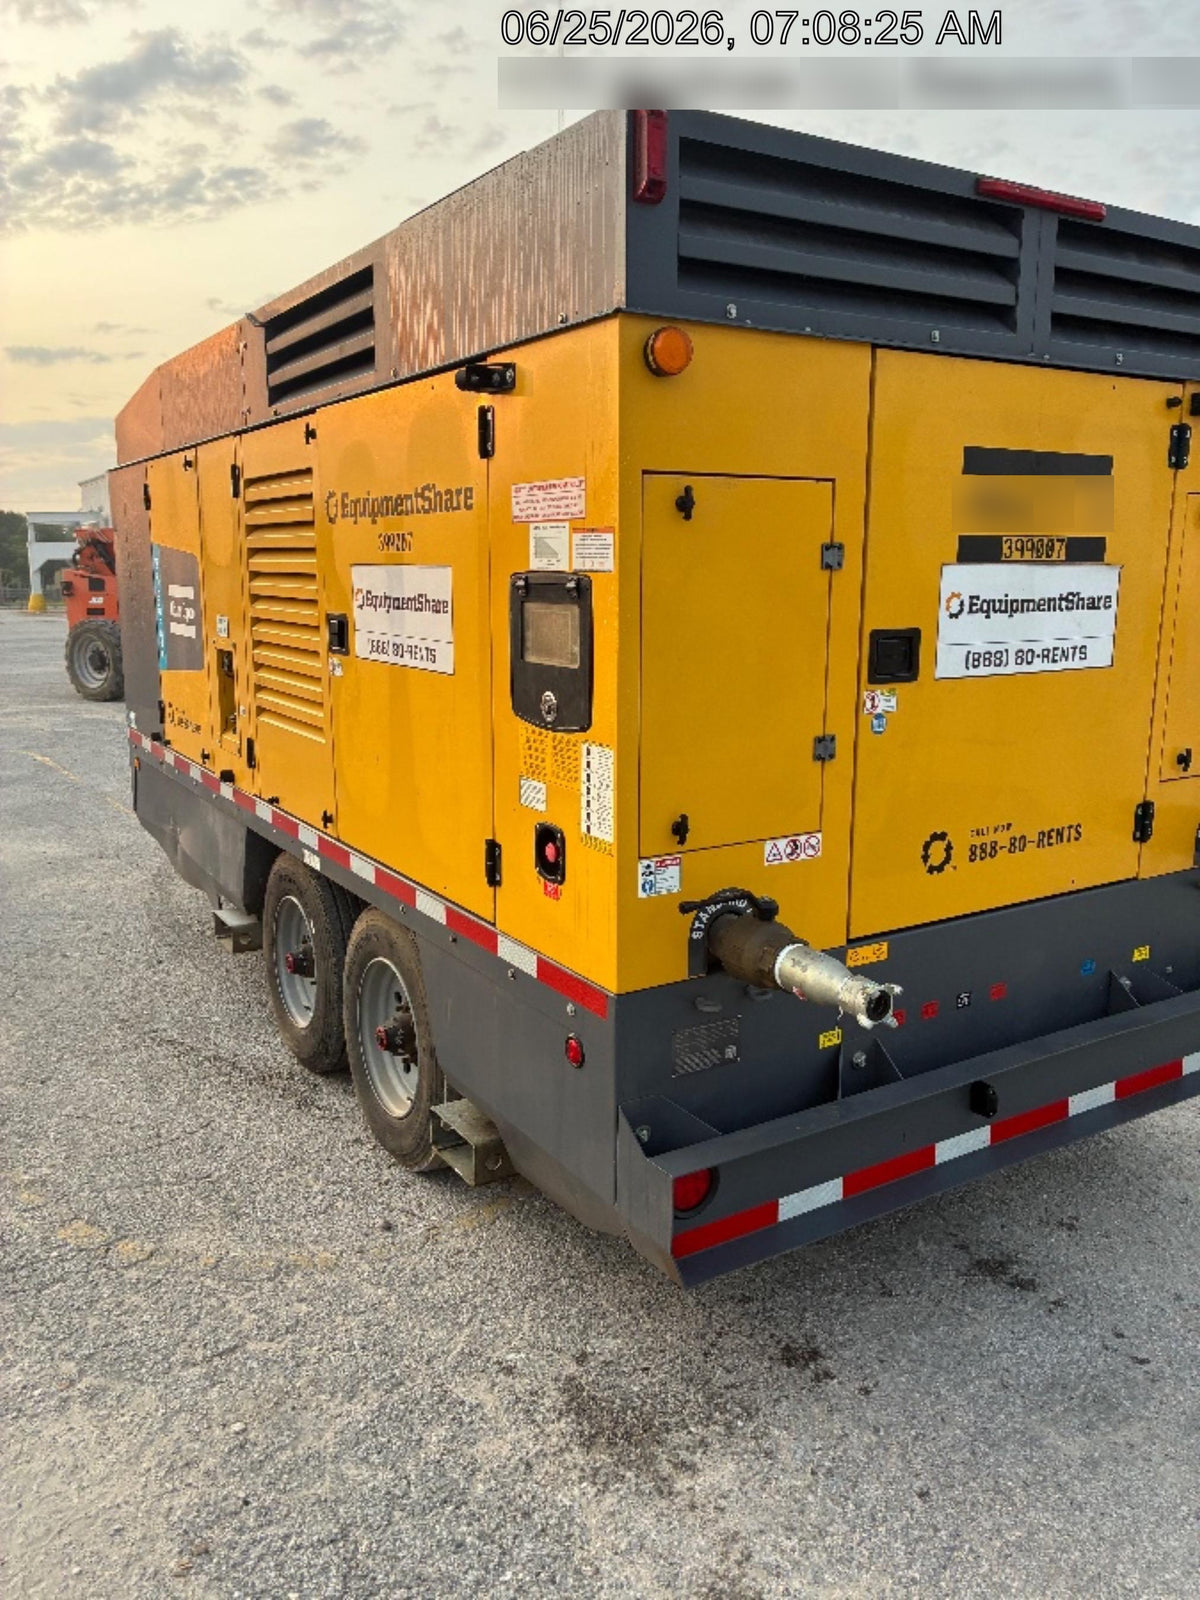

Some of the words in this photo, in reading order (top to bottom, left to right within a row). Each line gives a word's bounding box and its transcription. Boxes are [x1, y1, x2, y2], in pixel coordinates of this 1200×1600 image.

[341, 483, 474, 525] EquipmentShare
[365, 589, 449, 614] EquipmentShare
[967, 591, 1112, 620] EquipmentShare
[964, 651, 1009, 670] (888)
[1014, 645, 1088, 666] 80-RENTS
[968, 823, 1083, 863] 888-80-RENTS
